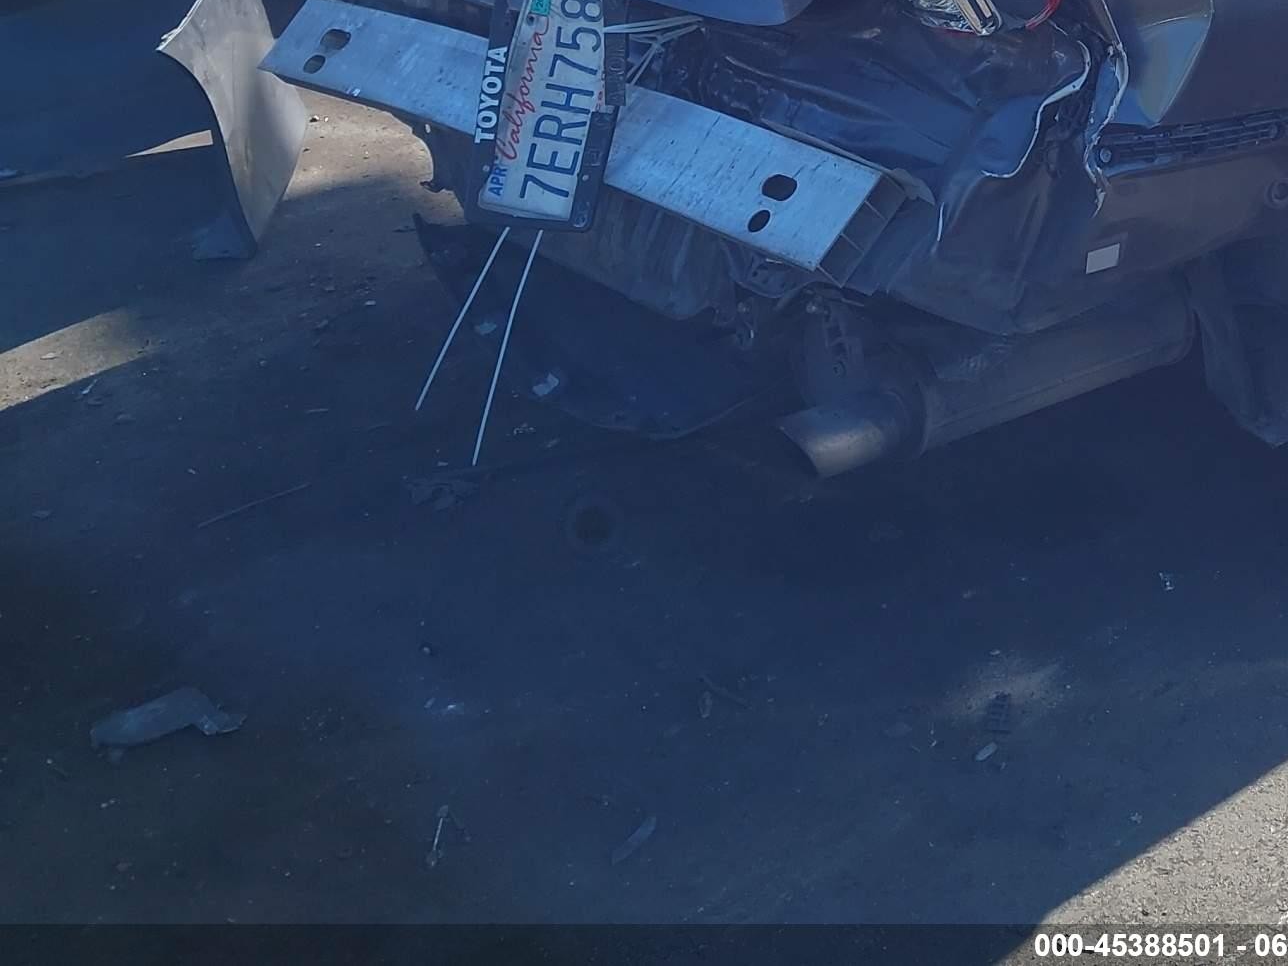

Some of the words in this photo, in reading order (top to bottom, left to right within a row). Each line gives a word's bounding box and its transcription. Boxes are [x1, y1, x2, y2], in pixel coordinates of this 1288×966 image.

[474, 46, 508, 144] TOYOTA
[495, 18, 549, 161] California
[487, 166, 508, 196] APR
